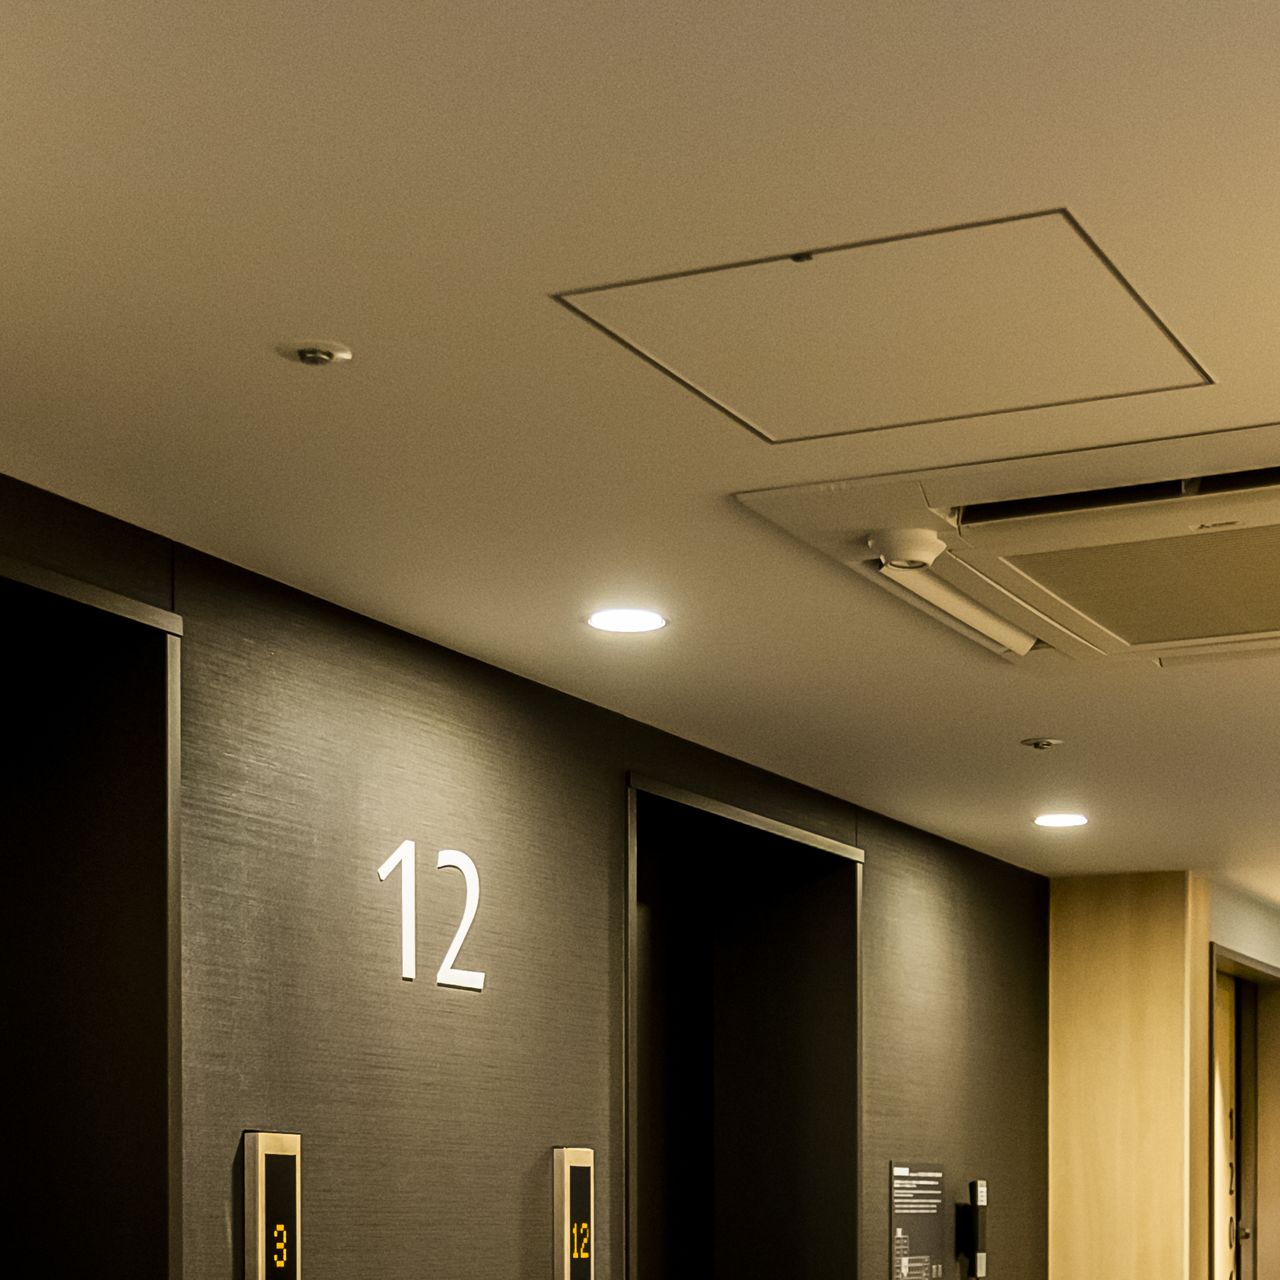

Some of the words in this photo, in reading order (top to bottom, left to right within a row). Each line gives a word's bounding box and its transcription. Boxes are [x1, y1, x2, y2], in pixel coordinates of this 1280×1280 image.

[377, 840, 486, 990] 12
[273, 1224, 287, 1268] 3
[572, 1222, 589, 1259] 12
